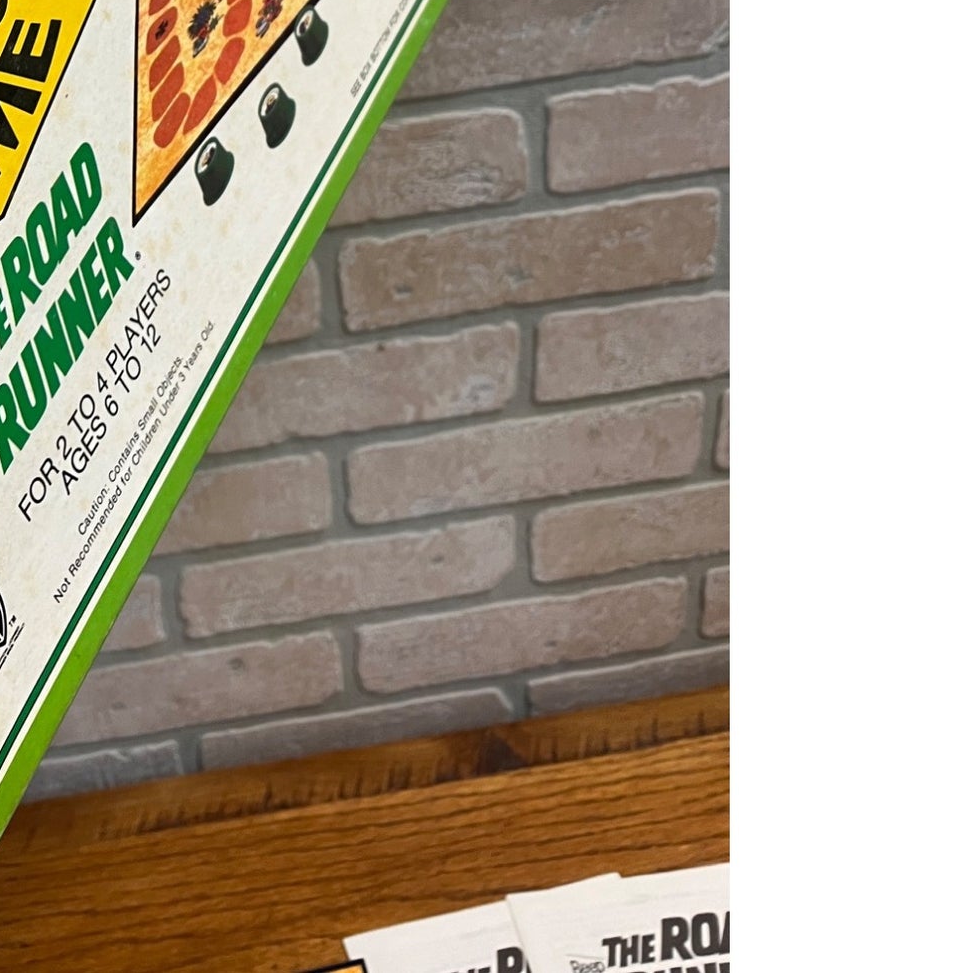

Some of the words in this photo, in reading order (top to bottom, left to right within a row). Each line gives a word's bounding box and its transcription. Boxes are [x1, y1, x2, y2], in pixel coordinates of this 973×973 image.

[0, 142, 102, 327] ROAD
[18, 457, 60, 522] FOR
[56, 435, 73, 461] 2
[67, 393, 96, 434] TO
[96, 370, 109, 394] 4
[105, 268, 172, 375] PLAYERS
[53, 577, 71, 604] Not
[68, 487, 123, 578] Recommended
[121, 466, 133, 485] for
[131, 417, 162, 466] Children
[158, 380, 181, 417] Under
[178, 372, 186, 383] 3
[183, 342, 203, 372] Years
[61, 415, 107, 496] AGES
[104, 394, 119, 417] 6
[114, 355, 141, 394] TO
[140, 323, 162, 353] 12
[77, 484, 110, 537] Caution:
[108, 431, 140, 483] Contains
[137, 397, 158, 431] Small
[156, 355, 184, 398] Objects.
[602, 933, 657, 968] THE
